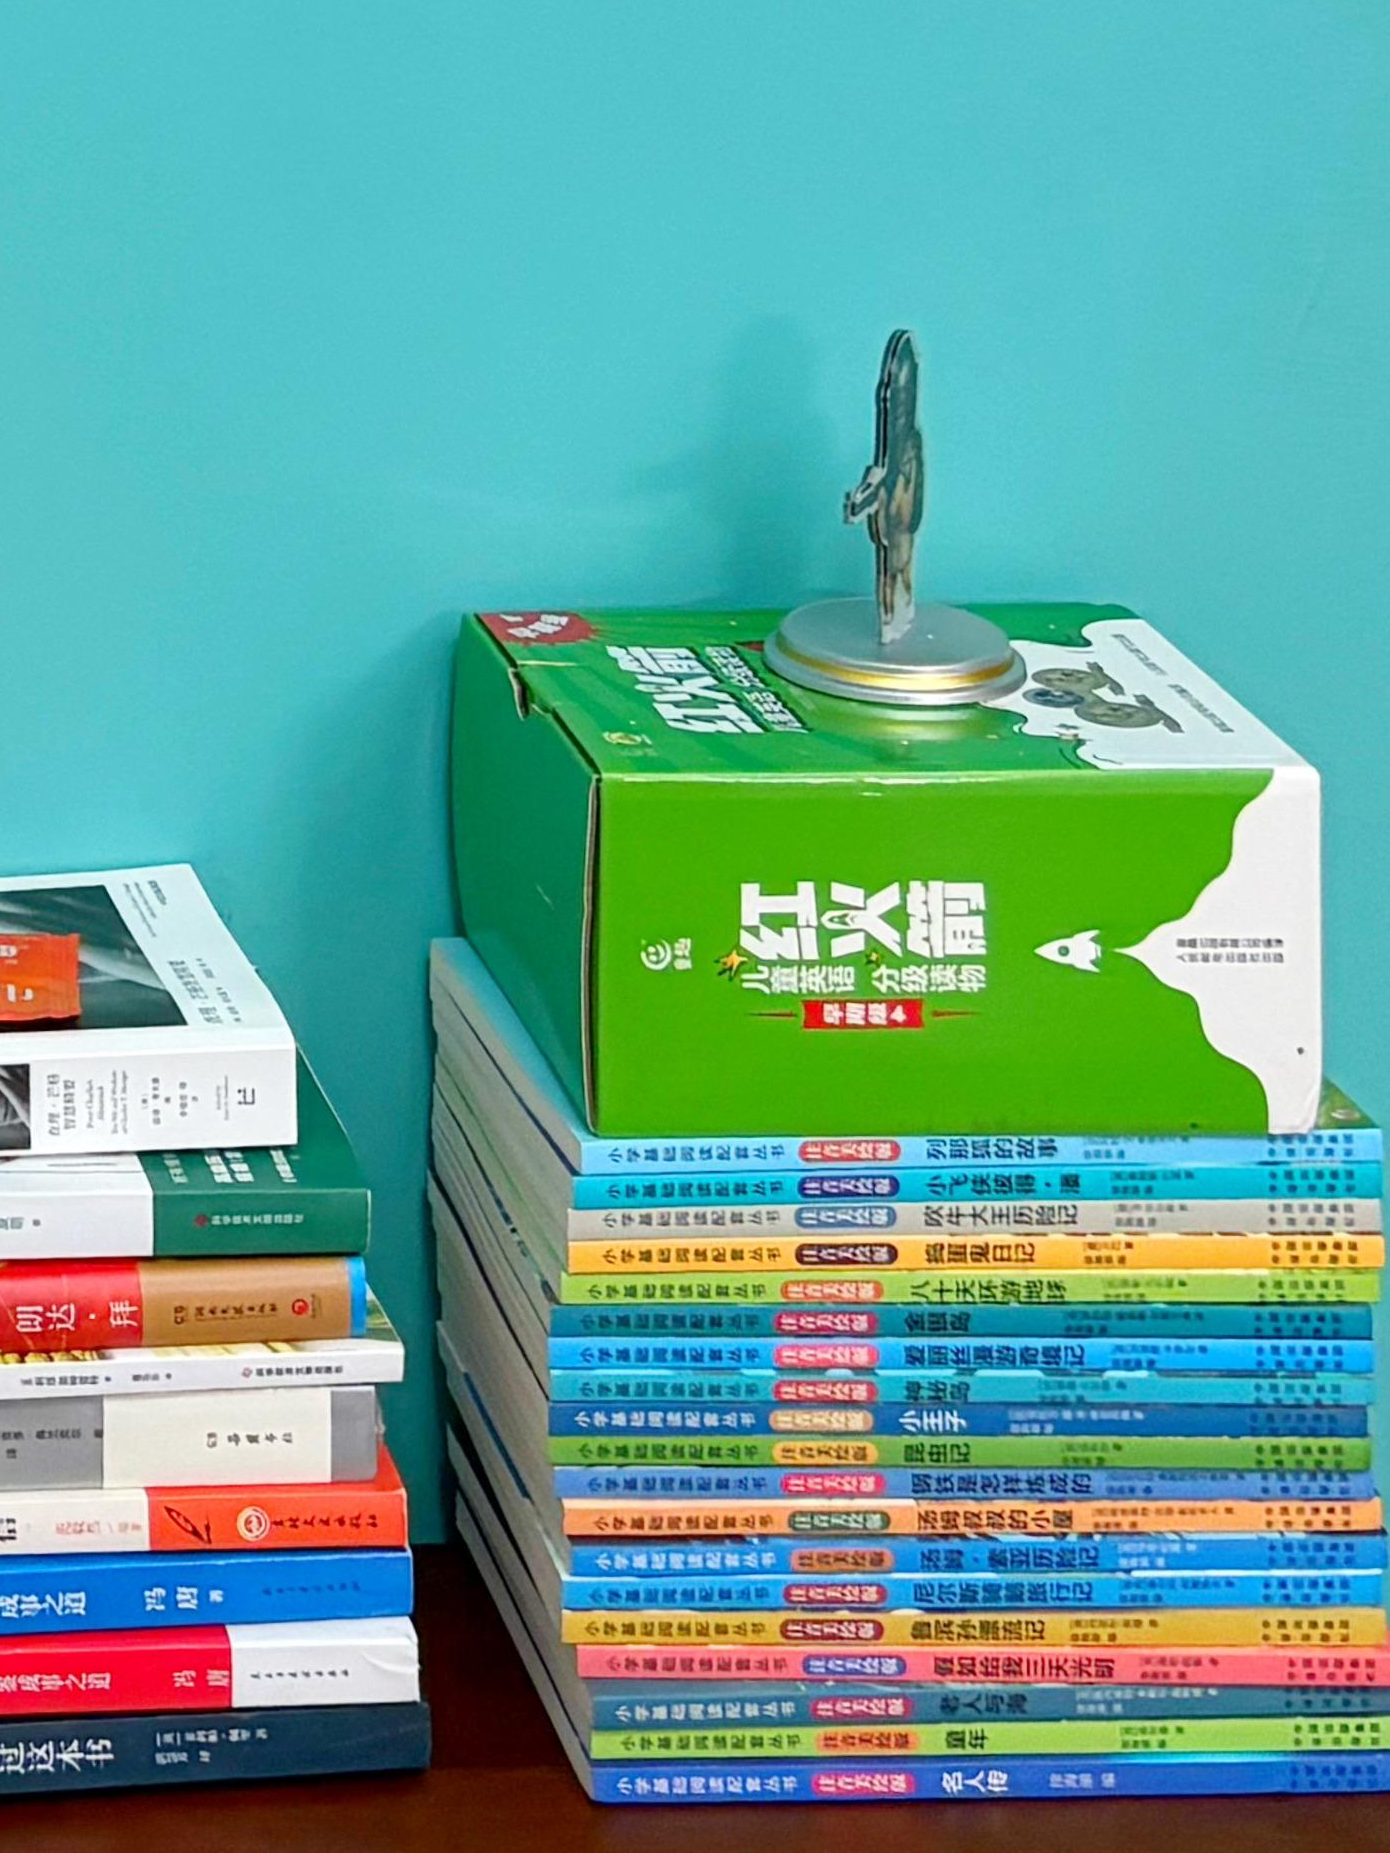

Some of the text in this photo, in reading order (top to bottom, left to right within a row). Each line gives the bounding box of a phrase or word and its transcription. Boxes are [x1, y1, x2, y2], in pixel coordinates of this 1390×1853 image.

[605, 645, 764, 733] 红火箭
[739, 880, 986, 961] 红火箭
[740, 963, 986, 995] 儿童英语 分级读物
[608, 1137, 1059, 1164] 小学基础阅读配套丛书 注音美绘版 列那狐的故事
[607, 1180, 784, 1199] 小学基础阅读配套丛书
[802, 1176, 891, 1194] 注音美绘版
[602, 1204, 1079, 1228] 小学基础阅读配套丛书 注音美绘版 吹牛大王历险记
[603, 1241, 1036, 1265] 小学基础阅读配套丛书 注音美绘版 捣蛋鬼日记
[589, 1275, 1067, 1303] 小学基础阅读配套丛书 注音美绘版 八十天环游地球
[779, 1312, 869, 1332] 注音美绘版
[904, 1312, 970, 1334] 金银岛
[579, 1344, 1085, 1368] 小学基础阅读配套丛书 注音美绘版 爱丽丝漫游奇境记
[779, 1382, 869, 1400] 注音美绘版
[574, 1409, 968, 1433] 小学基础阅读配套丛书 注音美绘版 小王子
[578, 1443, 970, 1464] 小学基础阅读配套丛书 注音美绘版 昆虫记
[588, 1473, 1092, 1495] 小学基础阅读配套丛书 注音美绘版 钢铁是怎样炼成的
[593, 1514, 774, 1532] 小学基础阅读配套丛书
[793, 1512, 882, 1530] 注音美绘版
[917, 1509, 1074, 1531] 汤姆叔叔的小屋
[595, 1546, 1099, 1571] 小学基础阅读配套丛书 注音美绘版 汤姆·索亚历险记
[144, 1586, 198, 1611] 冯唐
[589, 1582, 1094, 1605] 小学基础阅读配套丛书 注音美绘版 尼尔斯骑鹅旅行记
[585, 1619, 1046, 1642] 小学基础阅读配套丛书 注音美绘版 鲁滨孙漂流记
[173, 1669, 230, 1687] 冯唐
[607, 1657, 1115, 1679] 小学基础阅读配套丛书 注音美绘版 假如给我三天光明
[615, 1693, 1028, 1722] 小学基础阅读配套丛书 注音美绘版 老人与海
[621, 1728, 989, 1751] 小学基础阅读配套丛书 注音美绘版 童年
[617, 1769, 1009, 1795] 小学基础阅读配套丛书 注音美绘版 名人传
